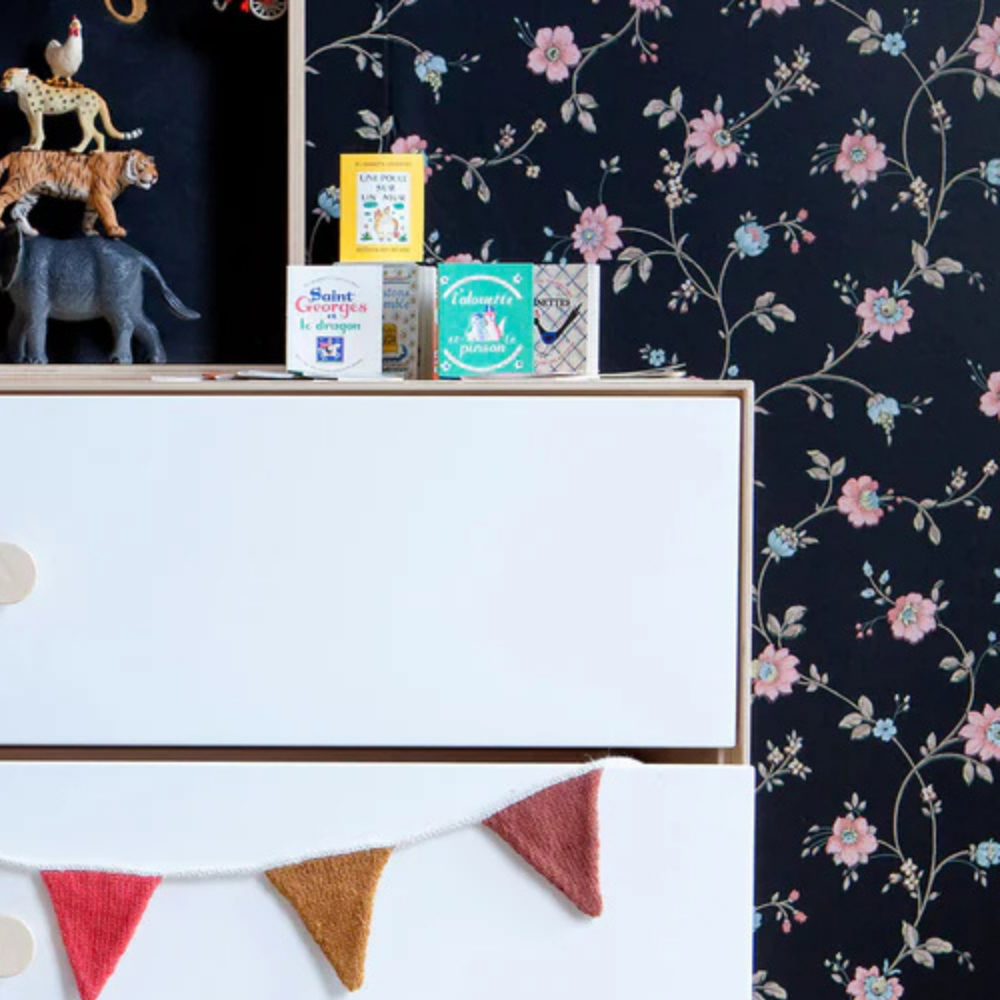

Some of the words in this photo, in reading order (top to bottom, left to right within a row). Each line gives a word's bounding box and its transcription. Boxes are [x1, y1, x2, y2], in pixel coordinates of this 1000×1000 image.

[359, 174, 378, 182] UNE
[310, 286, 354, 302] Saint
[294, 295, 368, 319] Georges
[315, 319, 361, 334] dragon
[459, 344, 506, 359] pinson
